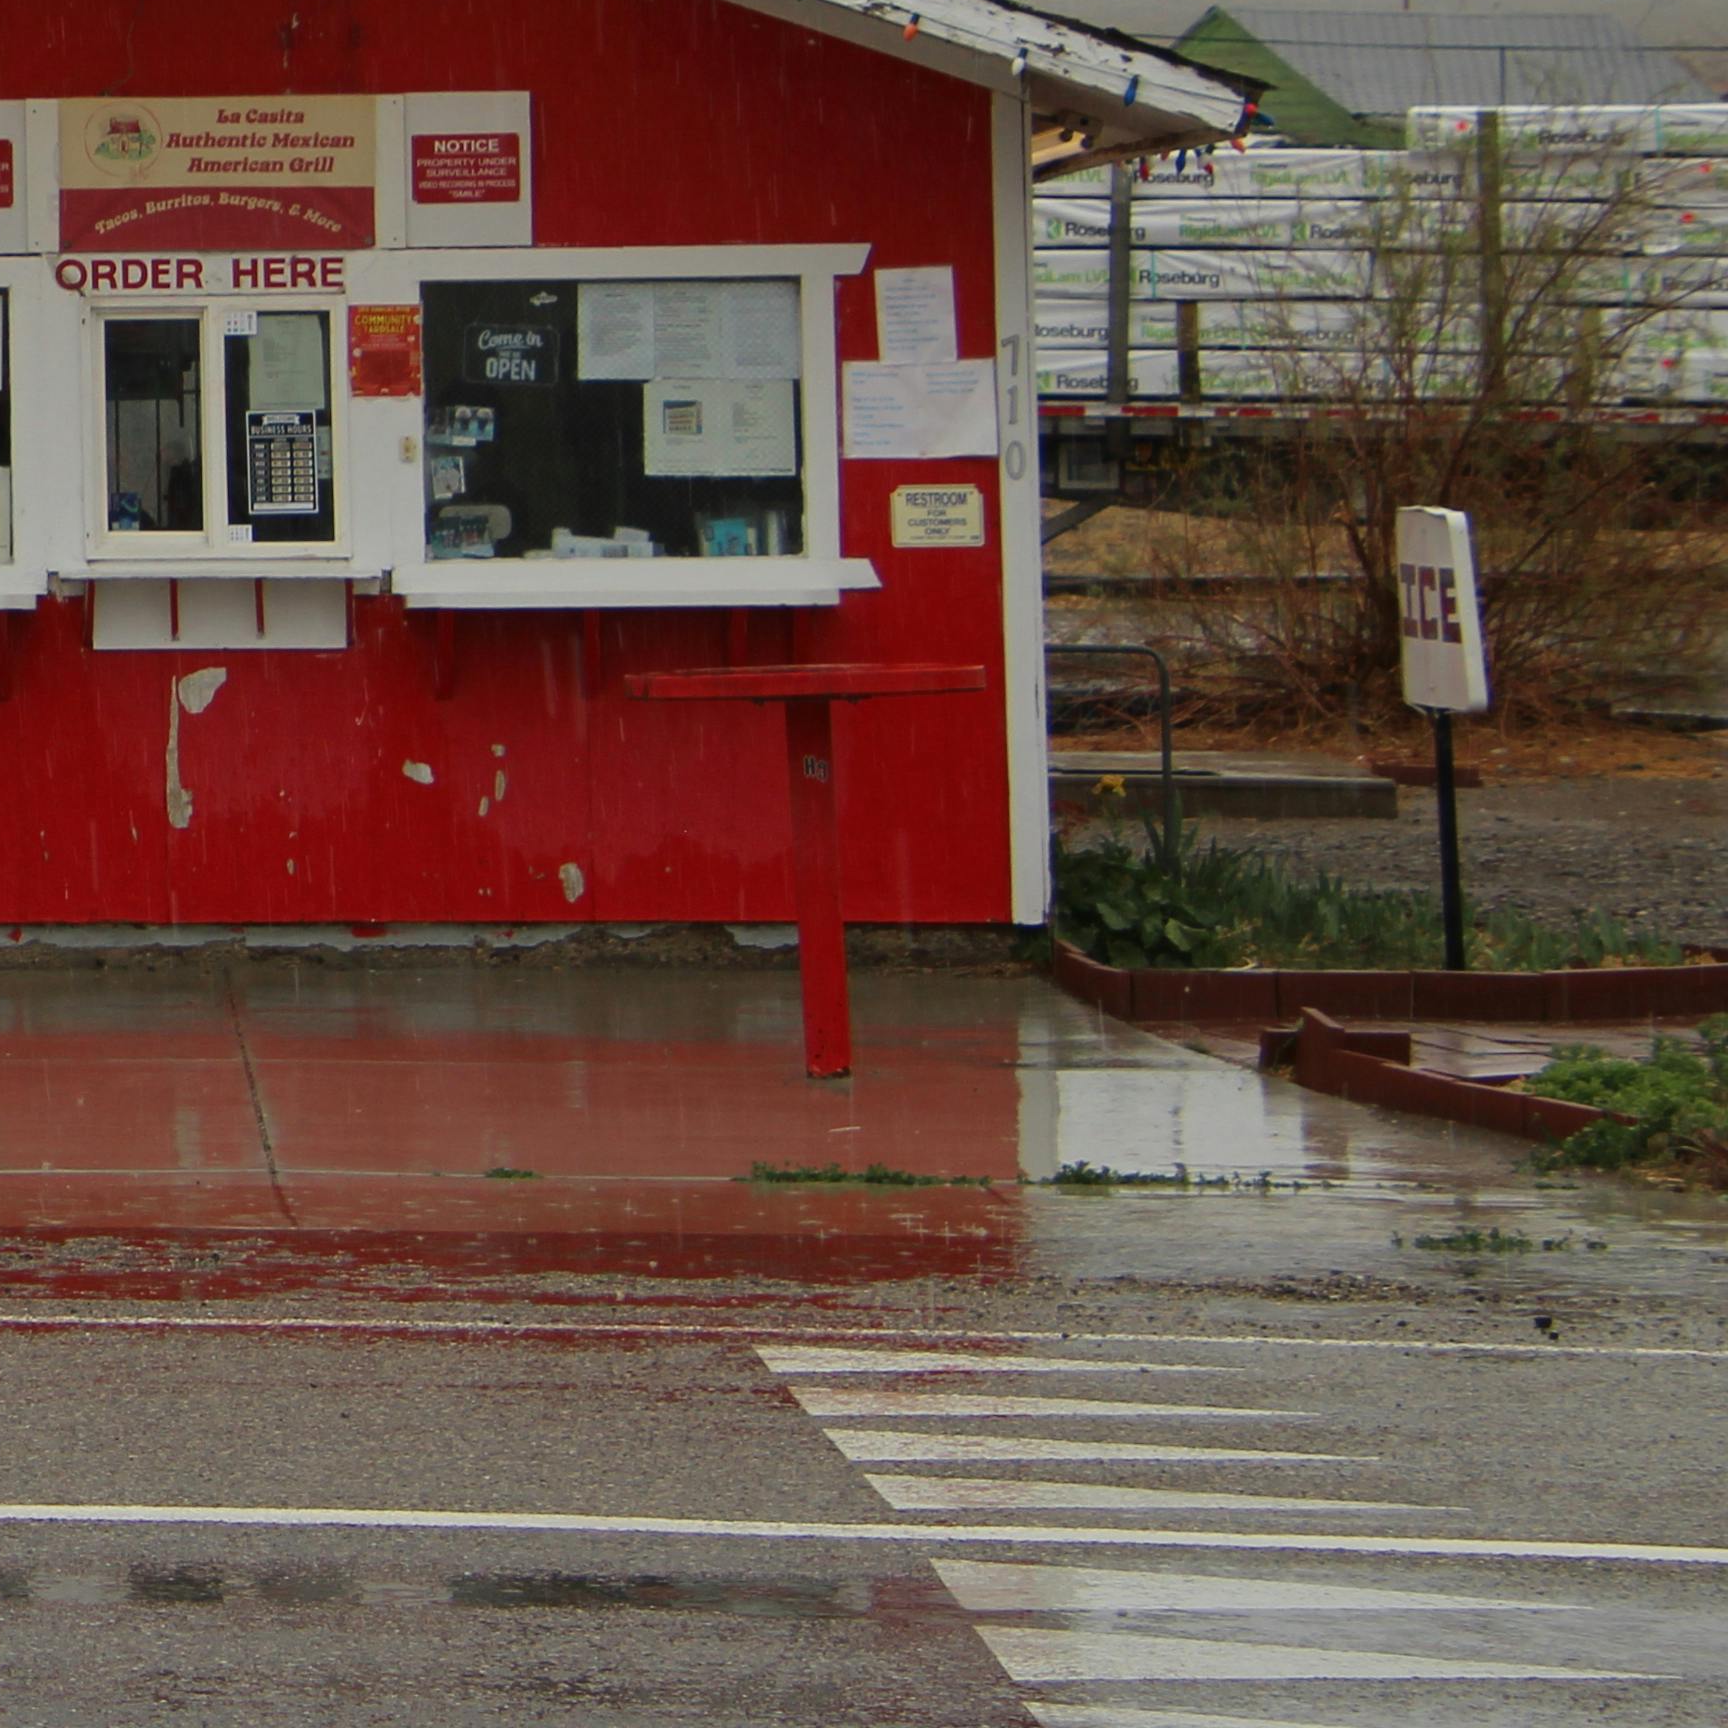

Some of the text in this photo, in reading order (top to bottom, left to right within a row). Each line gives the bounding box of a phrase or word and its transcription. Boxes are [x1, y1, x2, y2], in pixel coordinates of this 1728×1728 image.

[216, 109, 305, 124] La Casita
[165, 132, 355, 149] Authentic Mexican
[434, 139, 499, 152] NOTICE
[187, 156, 334, 173] American Grill
[417, 157, 516, 167] PROPERTY UNDER
[303, 209, 342, 233] More
[1065, 222, 1146, 240] Roserg
[55, 257, 344, 290] ORDER HERE
[477, 329, 525, 350] Come
[1034, 324, 1110, 341] oseburg
[486, 357, 536, 381] OPEN
[1056, 373, 1138, 391] Rosebg
[1001, 334, 1026, 481] 710
[287, 424, 312, 434] HOURS
[905, 492, 968, 507] RESTROOM
[1400, 564, 1462, 644] ICE
